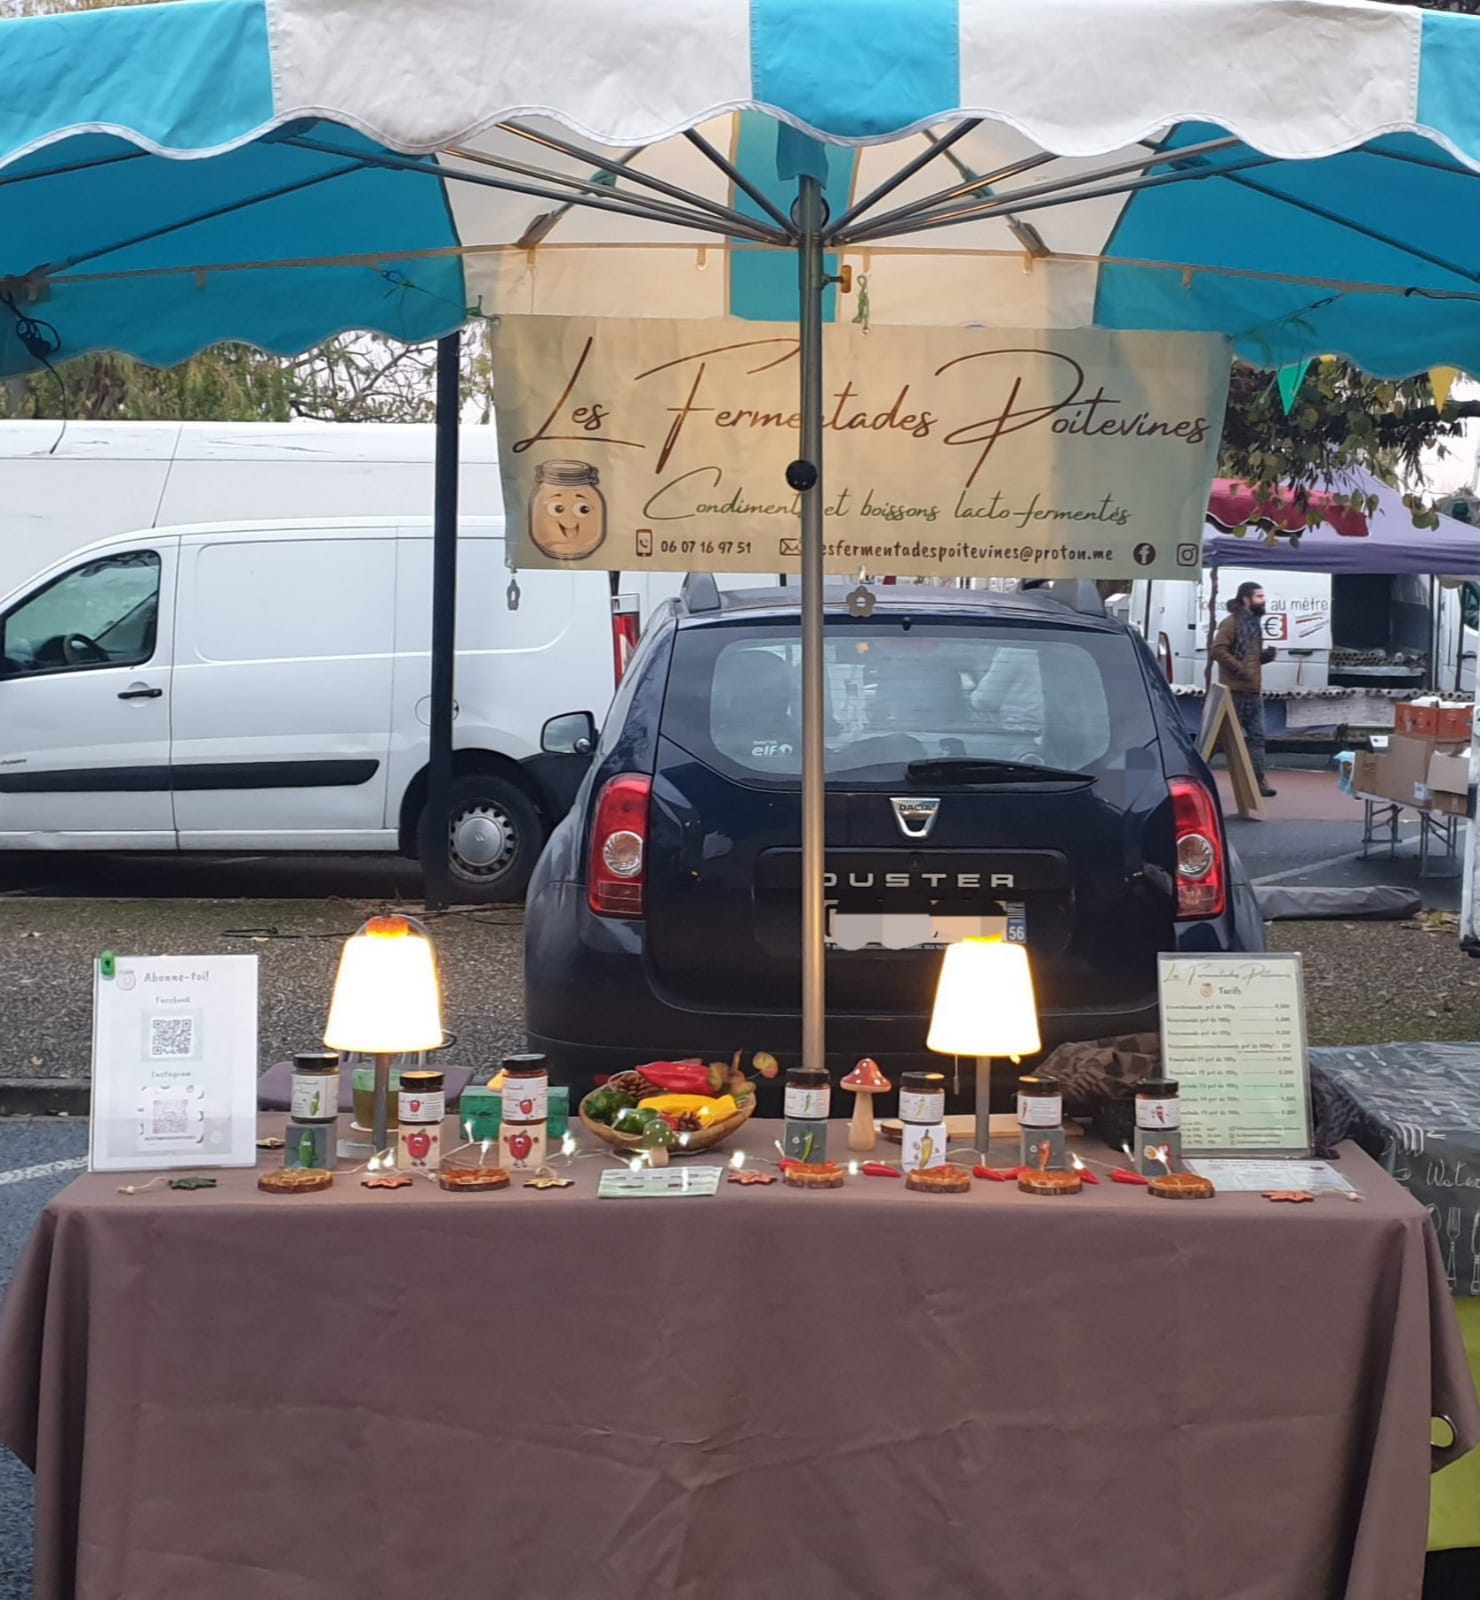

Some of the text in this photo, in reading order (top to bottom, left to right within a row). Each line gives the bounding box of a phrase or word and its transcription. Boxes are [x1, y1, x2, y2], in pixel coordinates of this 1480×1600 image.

[511, 336, 1210, 488] Les Fermetades Poitevines
[643, 466, 1132, 528] Condiment et boissons lacto-fermentés
[661, 540, 752, 554] 06 07 16 97 51
[821, 540, 1113, 563] esfermentadespoitevines@proton.me
[1270, 600, 1286, 611] au
[1009, 925, 1025, 941] 56
